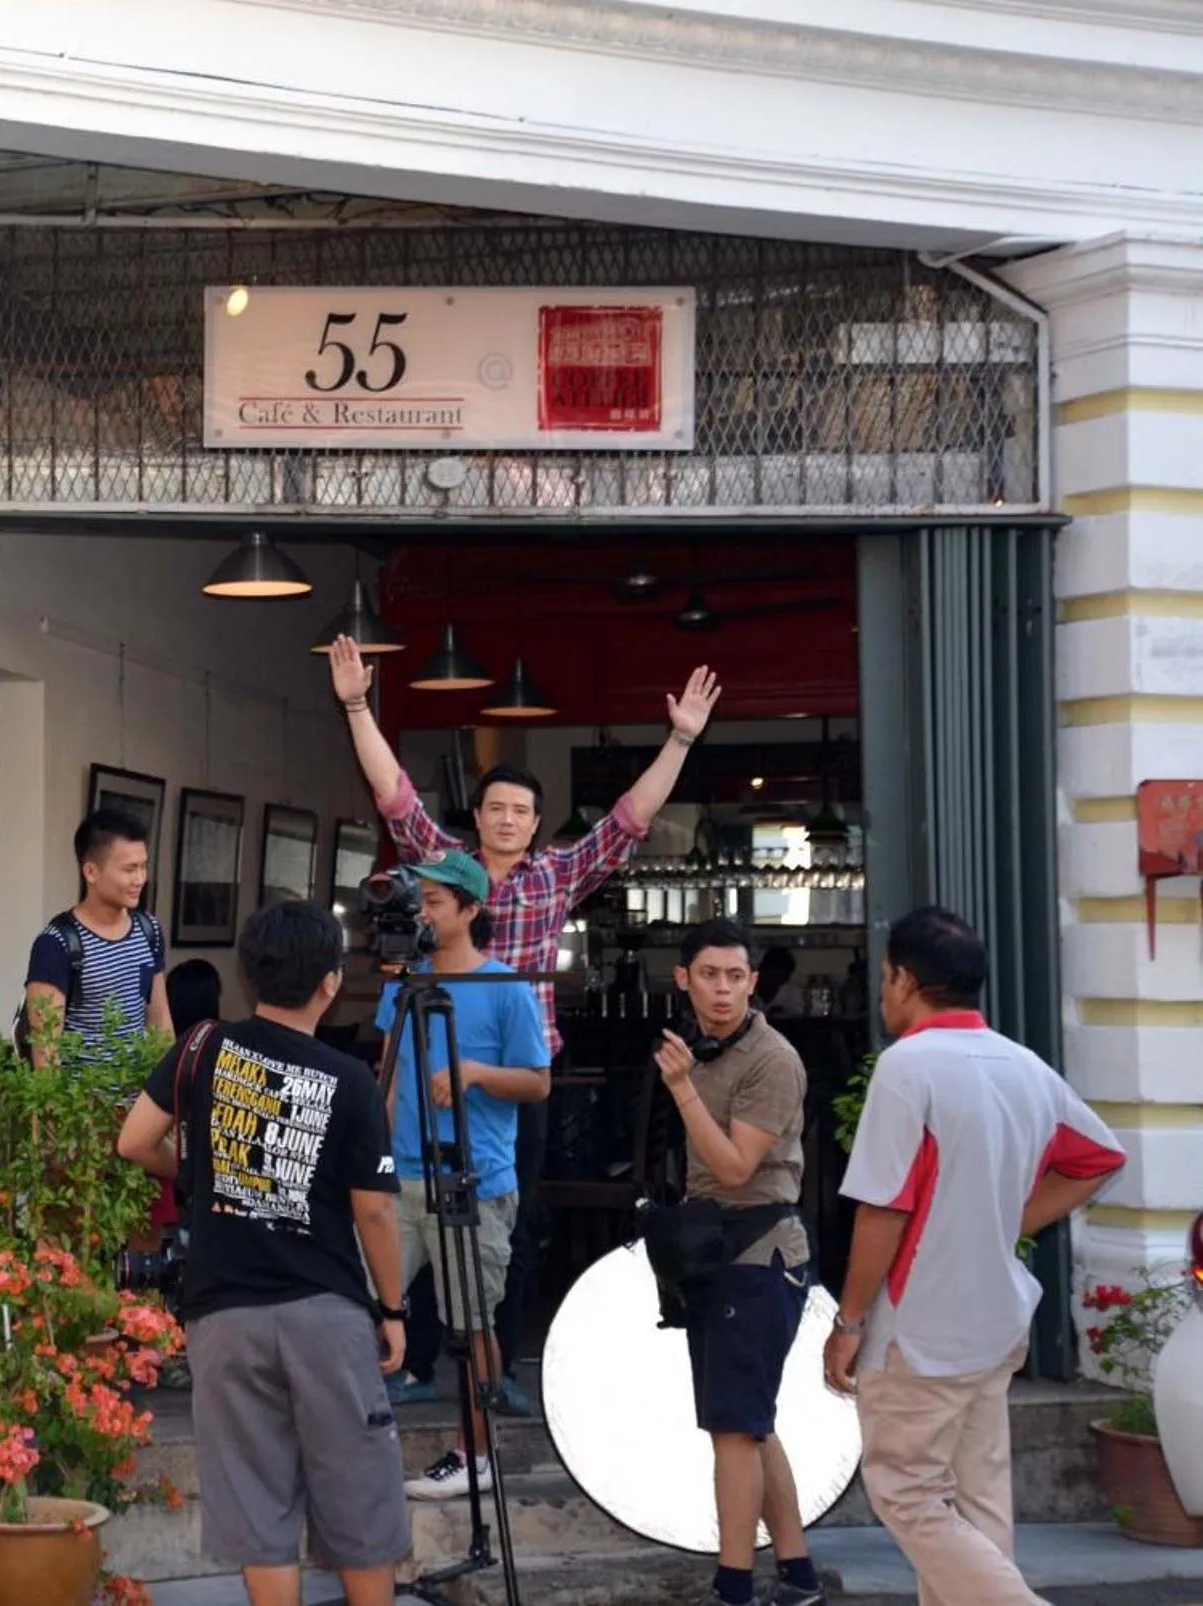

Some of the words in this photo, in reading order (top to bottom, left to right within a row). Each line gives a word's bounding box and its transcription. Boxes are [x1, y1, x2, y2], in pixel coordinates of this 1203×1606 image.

[305, 311, 409, 392] 55
[238, 400, 295, 425] Café
[302, 402, 322, 424] &
[334, 401, 464, 425] Restaurant
